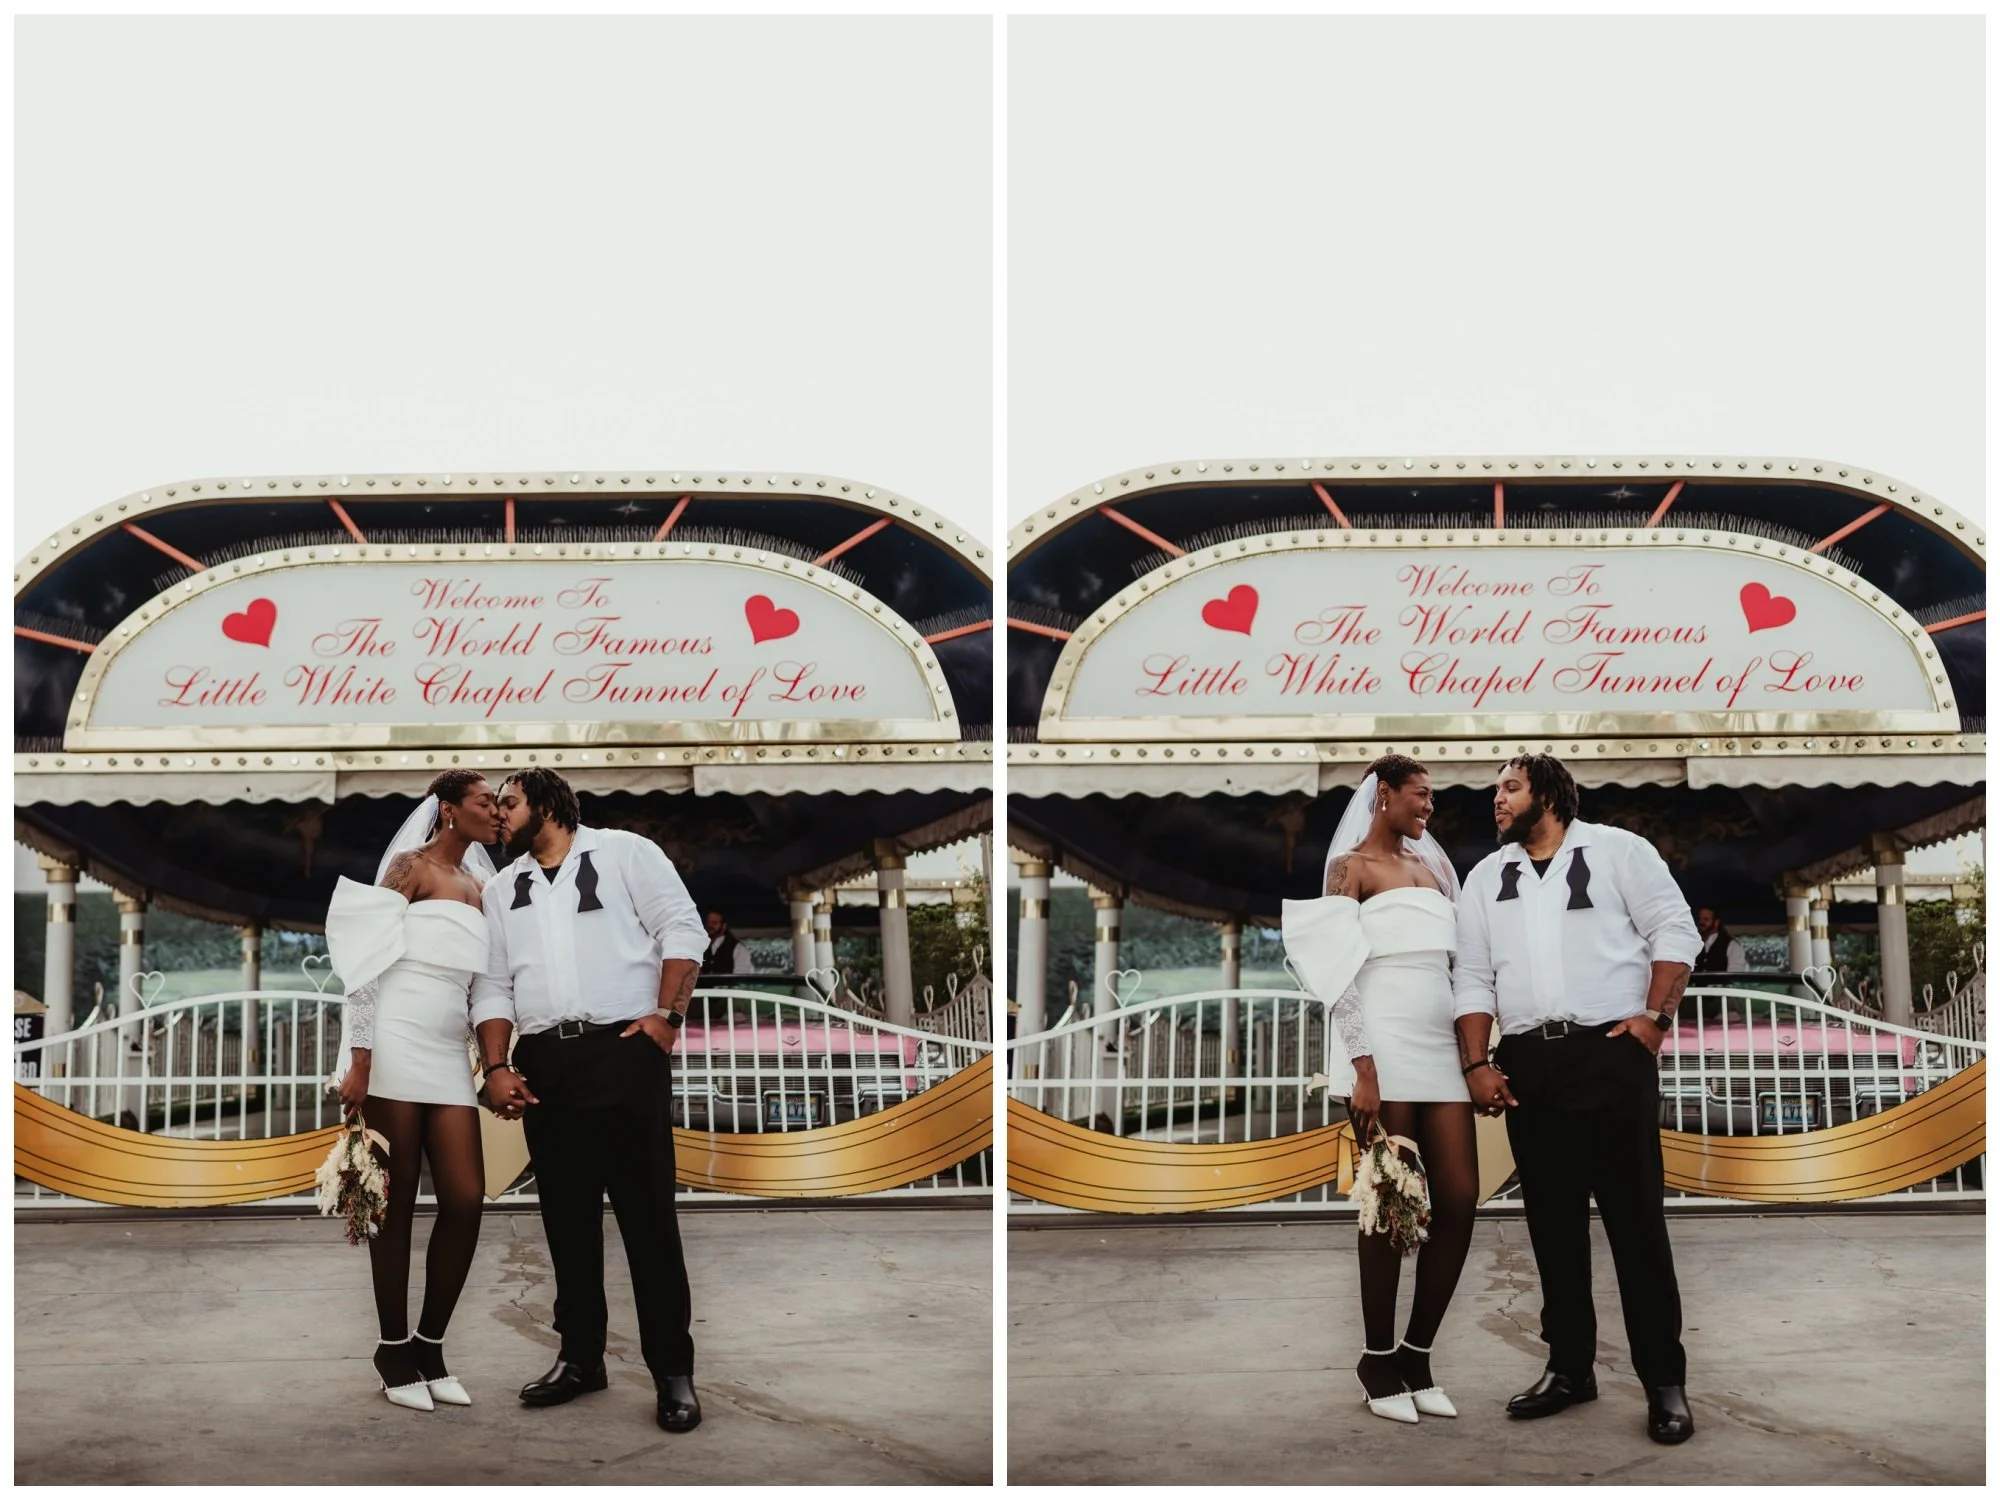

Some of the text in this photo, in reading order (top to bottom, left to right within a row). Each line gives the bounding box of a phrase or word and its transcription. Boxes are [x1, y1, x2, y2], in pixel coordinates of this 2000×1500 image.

[411, 578, 612, 609] Welcome To
[1397, 565, 1605, 598] Welcome To
[312, 617, 713, 657] The World Famous
[1295, 603, 1709, 646] The World Famous
[158, 661, 866, 719] Little White Chapel Tunnel of Love
[1137, 651, 1865, 709] Little White Chapel Tunnel of Love
